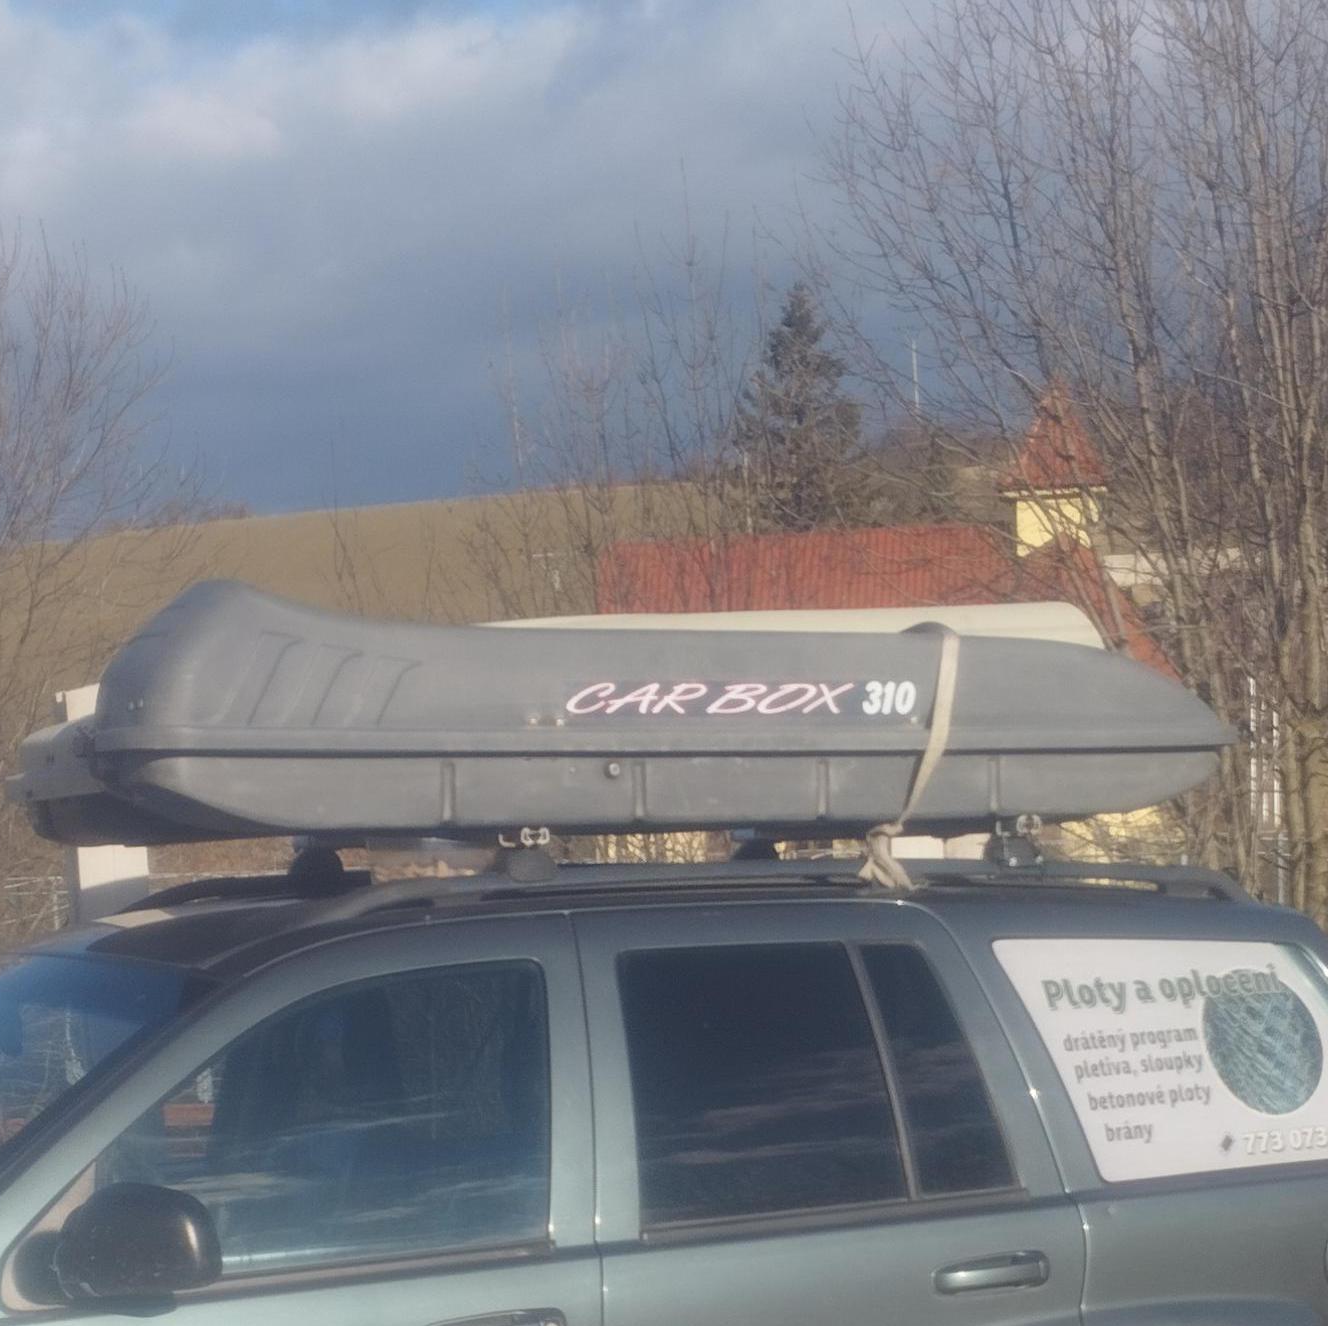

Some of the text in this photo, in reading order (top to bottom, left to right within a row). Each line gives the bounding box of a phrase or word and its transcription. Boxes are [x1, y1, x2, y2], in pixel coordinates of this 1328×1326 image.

[566, 680, 916, 716] CAR BOX 310
[1041, 976, 1127, 1014] Ploty
[1133, 979, 1156, 1003] a
[1129, 1027, 1199, 1050] program
[1140, 1050, 1204, 1075] sloupky
[1087, 1083, 1212, 1111] betonové ploty
[1104, 1120, 1153, 1144] brány
[1242, 1130, 1285, 1155] 773
[1289, 1126, 1328, 1149] 073
